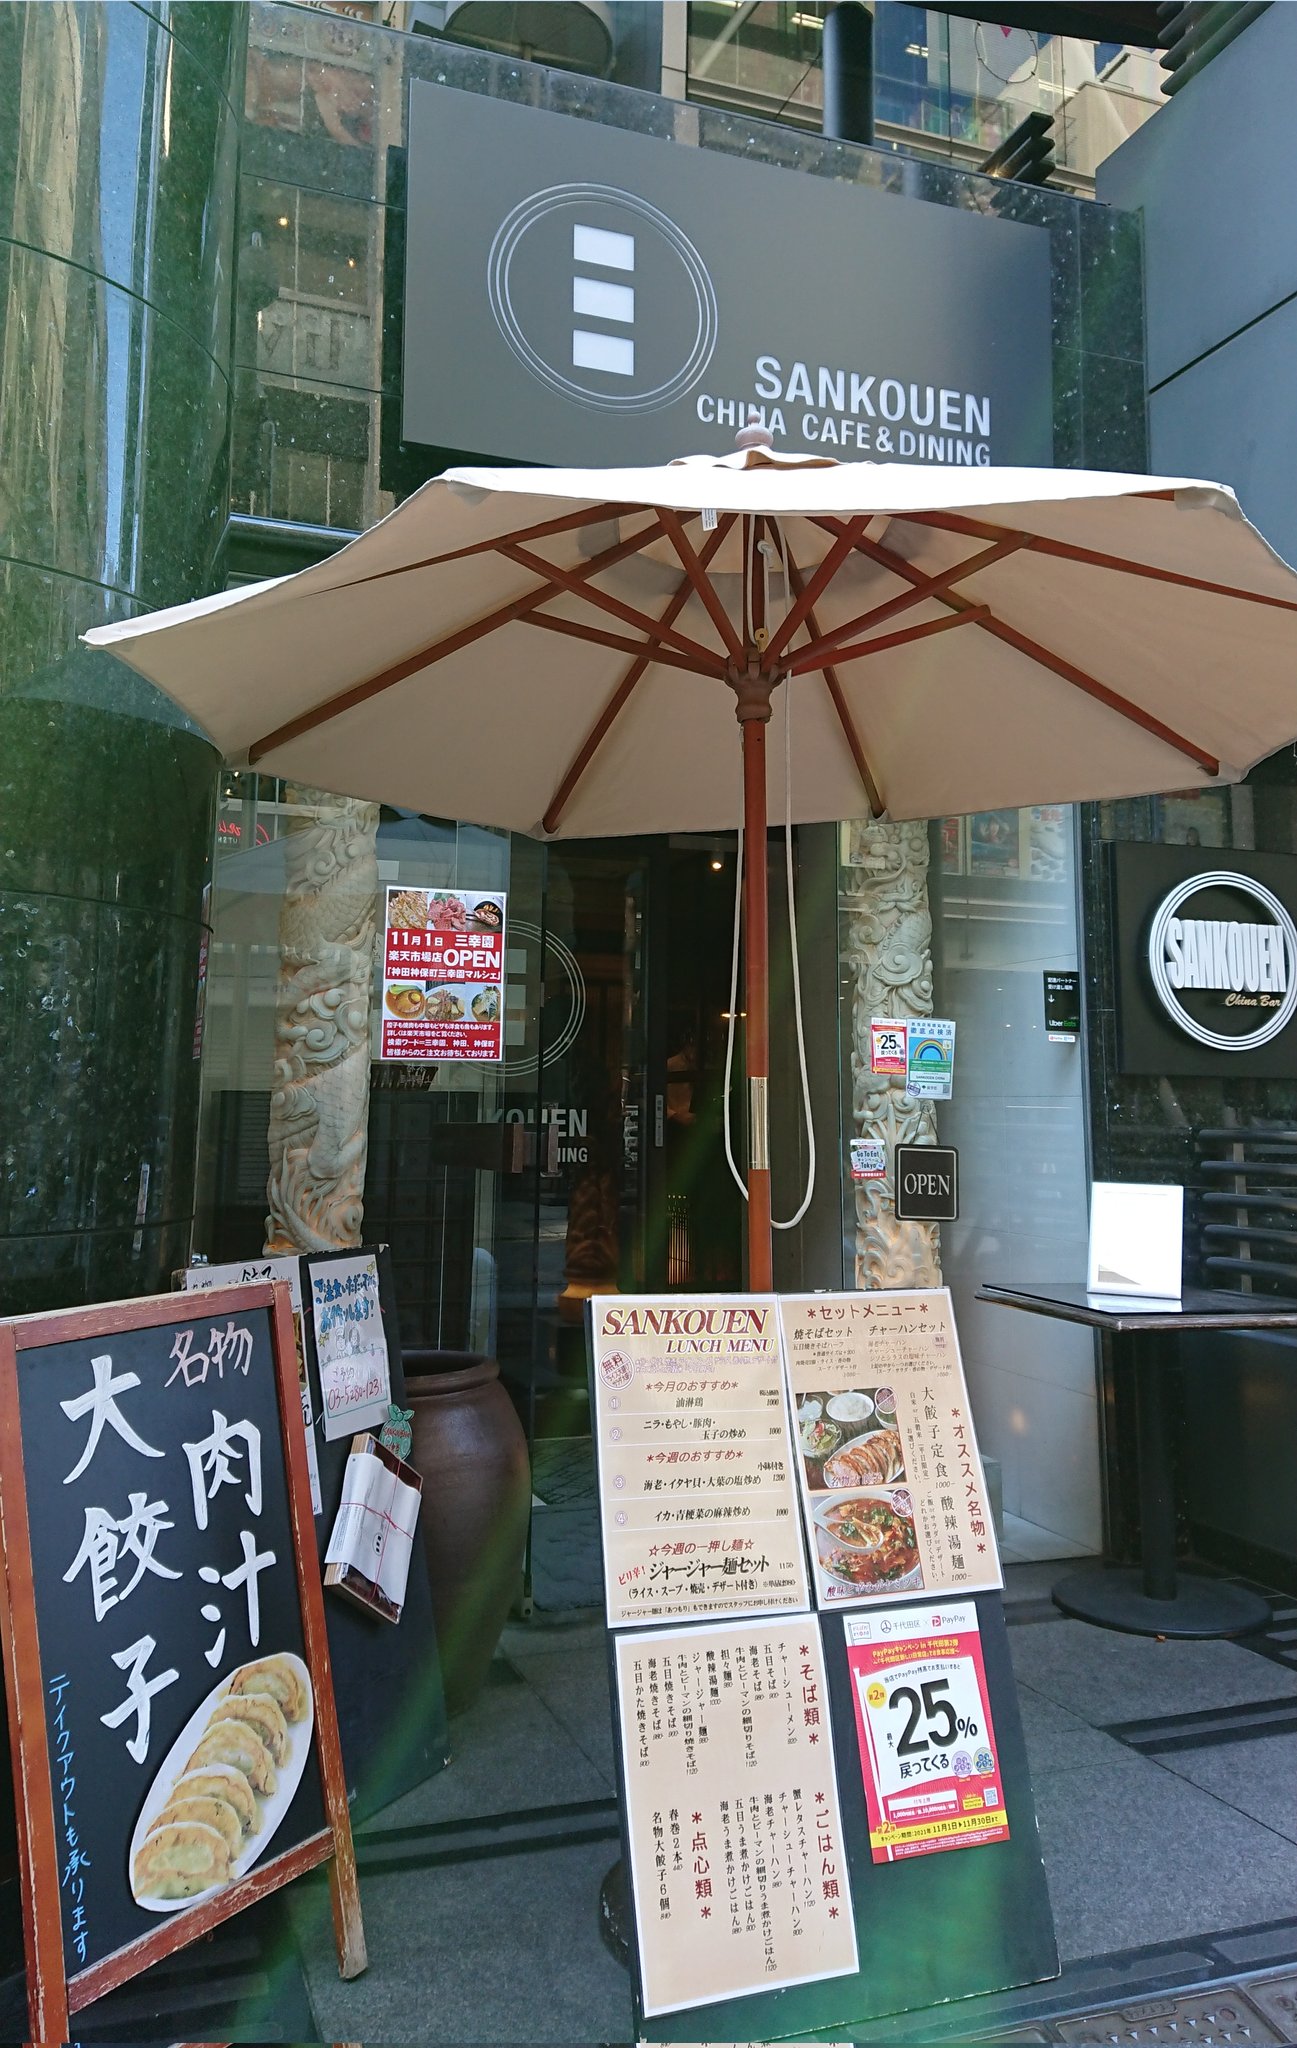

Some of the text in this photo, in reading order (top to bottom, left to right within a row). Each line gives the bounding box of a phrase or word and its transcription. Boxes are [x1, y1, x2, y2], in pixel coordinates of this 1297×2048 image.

[754, 355, 991, 437] SANKOUEN
[390, 931, 495, 949] 11月1日 三幸園
[1165, 917, 1287, 993] SANKOUEN
[1049, 1019, 1063, 1027] Uber
[1225, 992, 1281, 1007] China Bar
[904, 1173, 950, 1196] OPEN
[165, 1322, 254, 1388] 名物
[602, 1309, 770, 1336] SANKOUEN
[666, 1338, 774, 1354] LUNCH MENU
[793, 1327, 853, 1340] 焼そばセット
[869, 1321, 946, 1336] チャーハンセット
[701, 1429, 747, 1441] 玉子の炒め
[921, 1386, 948, 1479] 大餃子定食
[59, 1355, 183, 1765] 大餃子
[183, 1410, 277, 1669] 肉汁
[649, 1555, 770, 1581] ジャージャー麺セット
[941, 1496, 965, 1570] 酸辣湯麺
[941, 1615, 966, 1625] PayPay
[648, 1658, 662, 1732] 海老焼きそば
[662, 1657, 677, 1729] 五目焼きそば
[749, 1645, 762, 1692] 海老そば
[764, 1643, 777, 1690] 五目そば
[778, 1642, 796, 1738] チャーシューメン
[633, 1660, 649, 1758] 五目かた焼きそば
[677, 1654, 696, 1768] 牛肉とピーマンの細切り焼きそば
[735, 1647, 757, 1760] 牛肉とピーマンの細切りそば
[887, 1732, 894, 1748] 最大
[899, 1754, 950, 1780] 戻ってくる
[49, 1672, 92, 1964] テイクアウトも承ります
[669, 1808, 683, 1864] 春巻2本
[764, 1794, 780, 1880] 海老チャーハン
[793, 1788, 813, 1900] 蟹レタスチャーハン
[651, 1812, 670, 1911] 名物大餃子6個
[719, 1801, 741, 1927] 海老うま煮かけごはん
[735, 1799, 755, 1926] 五目うま煮かけごはん
[778, 1792, 801, 1929] チャーシューチャーハン
